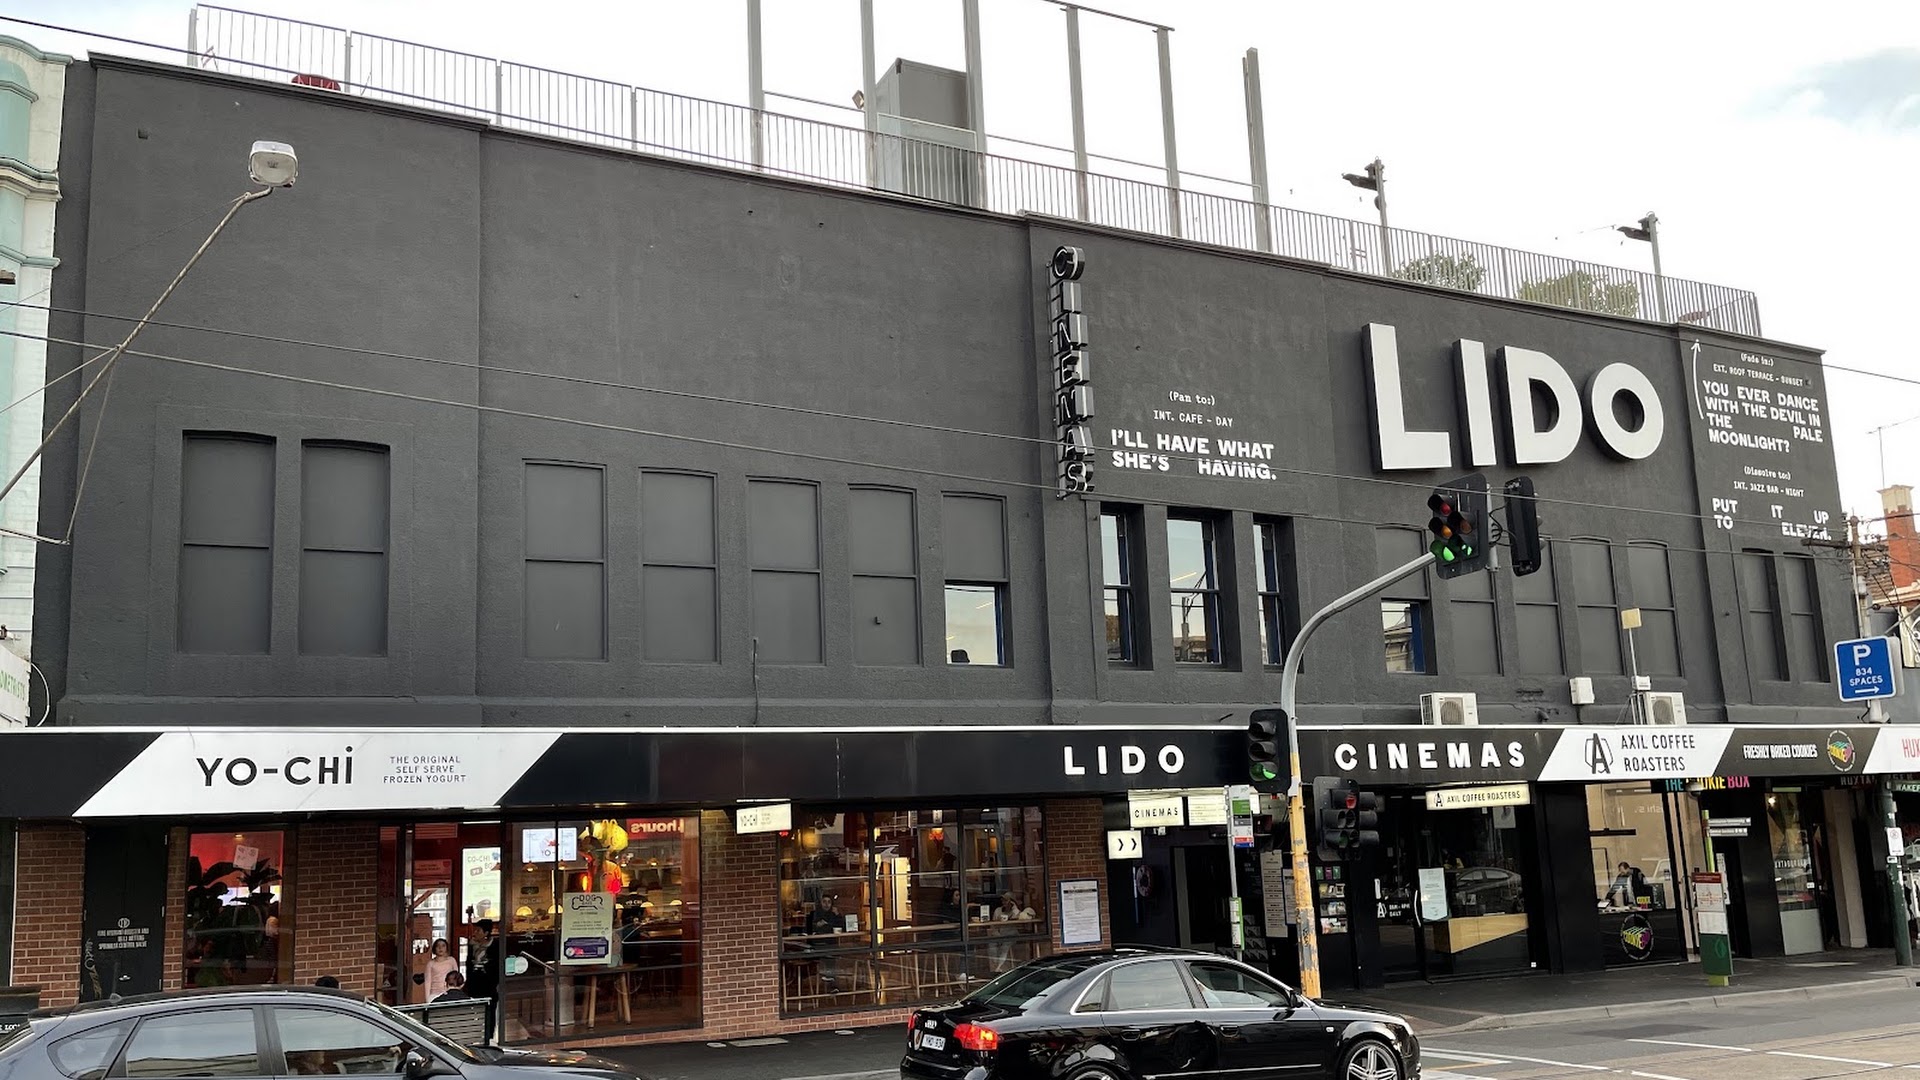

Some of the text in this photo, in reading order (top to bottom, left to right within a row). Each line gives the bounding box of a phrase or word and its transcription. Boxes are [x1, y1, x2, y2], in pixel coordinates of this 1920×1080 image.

[1052, 245, 1095, 492] CINEMAS
[1713, 363, 1728, 374] EXT.
[1729, 367, 1746, 376] ROOF
[1748, 370, 1774, 382] TERRACE
[1781, 376, 1804, 386] SUNSET
[1169, 390, 1216, 406] (Pan to:)
[1362, 322, 1664, 470] LIDO
[1702, 380, 1819, 412] YOU EVER DANCE
[1153, 410, 1174, 421] INT.
[1179, 412, 1203, 424] CAFE
[1216, 416, 1234, 428] DAY
[1704, 396, 1821, 427] WITH THE DEVIL IN
[1706, 413, 1824, 442] THE PALE
[1111, 429, 1274, 460] I'LL HAVE WHAT
[1708, 428, 1790, 453] MOONLIGHT?
[1112, 450, 1277, 480] SHE'S HAVING.
[1734, 480, 1748, 490] INT.
[1750, 483, 1765, 492] JAZZ
[1766, 484, 1779, 494] BAR
[1786, 488, 1804, 498] NIGHT
[1712, 498, 1830, 524] PUT IT UP
[1714, 514, 1734, 530] TO
[1852, 644, 1871, 666] P
[1850, 676, 1884, 686] SPACES
[1856, 668, 1872, 676] 834
[1621, 734, 1696, 750] AXIL COFFEE
[1742, 744, 1818, 758] FRESHLY BAKED COOKIES
[390, 756, 460, 764] THE ORIGINAL
[1064, 744, 1186, 776] LIDO
[1334, 741, 1525, 771] CINEMAS
[1624, 756, 1686, 772] ROASTERS
[396, 766, 455, 774] SELF SERVE
[426, 774, 466, 783] YOGURT
[1664, 778, 1684, 791] THE
[1726, 775, 1750, 788] BOX
[1462, 793, 1486, 802] COFFEE
[1487, 790, 1521, 801] ROASTERS
[1134, 807, 1179, 819] CINEMAS
